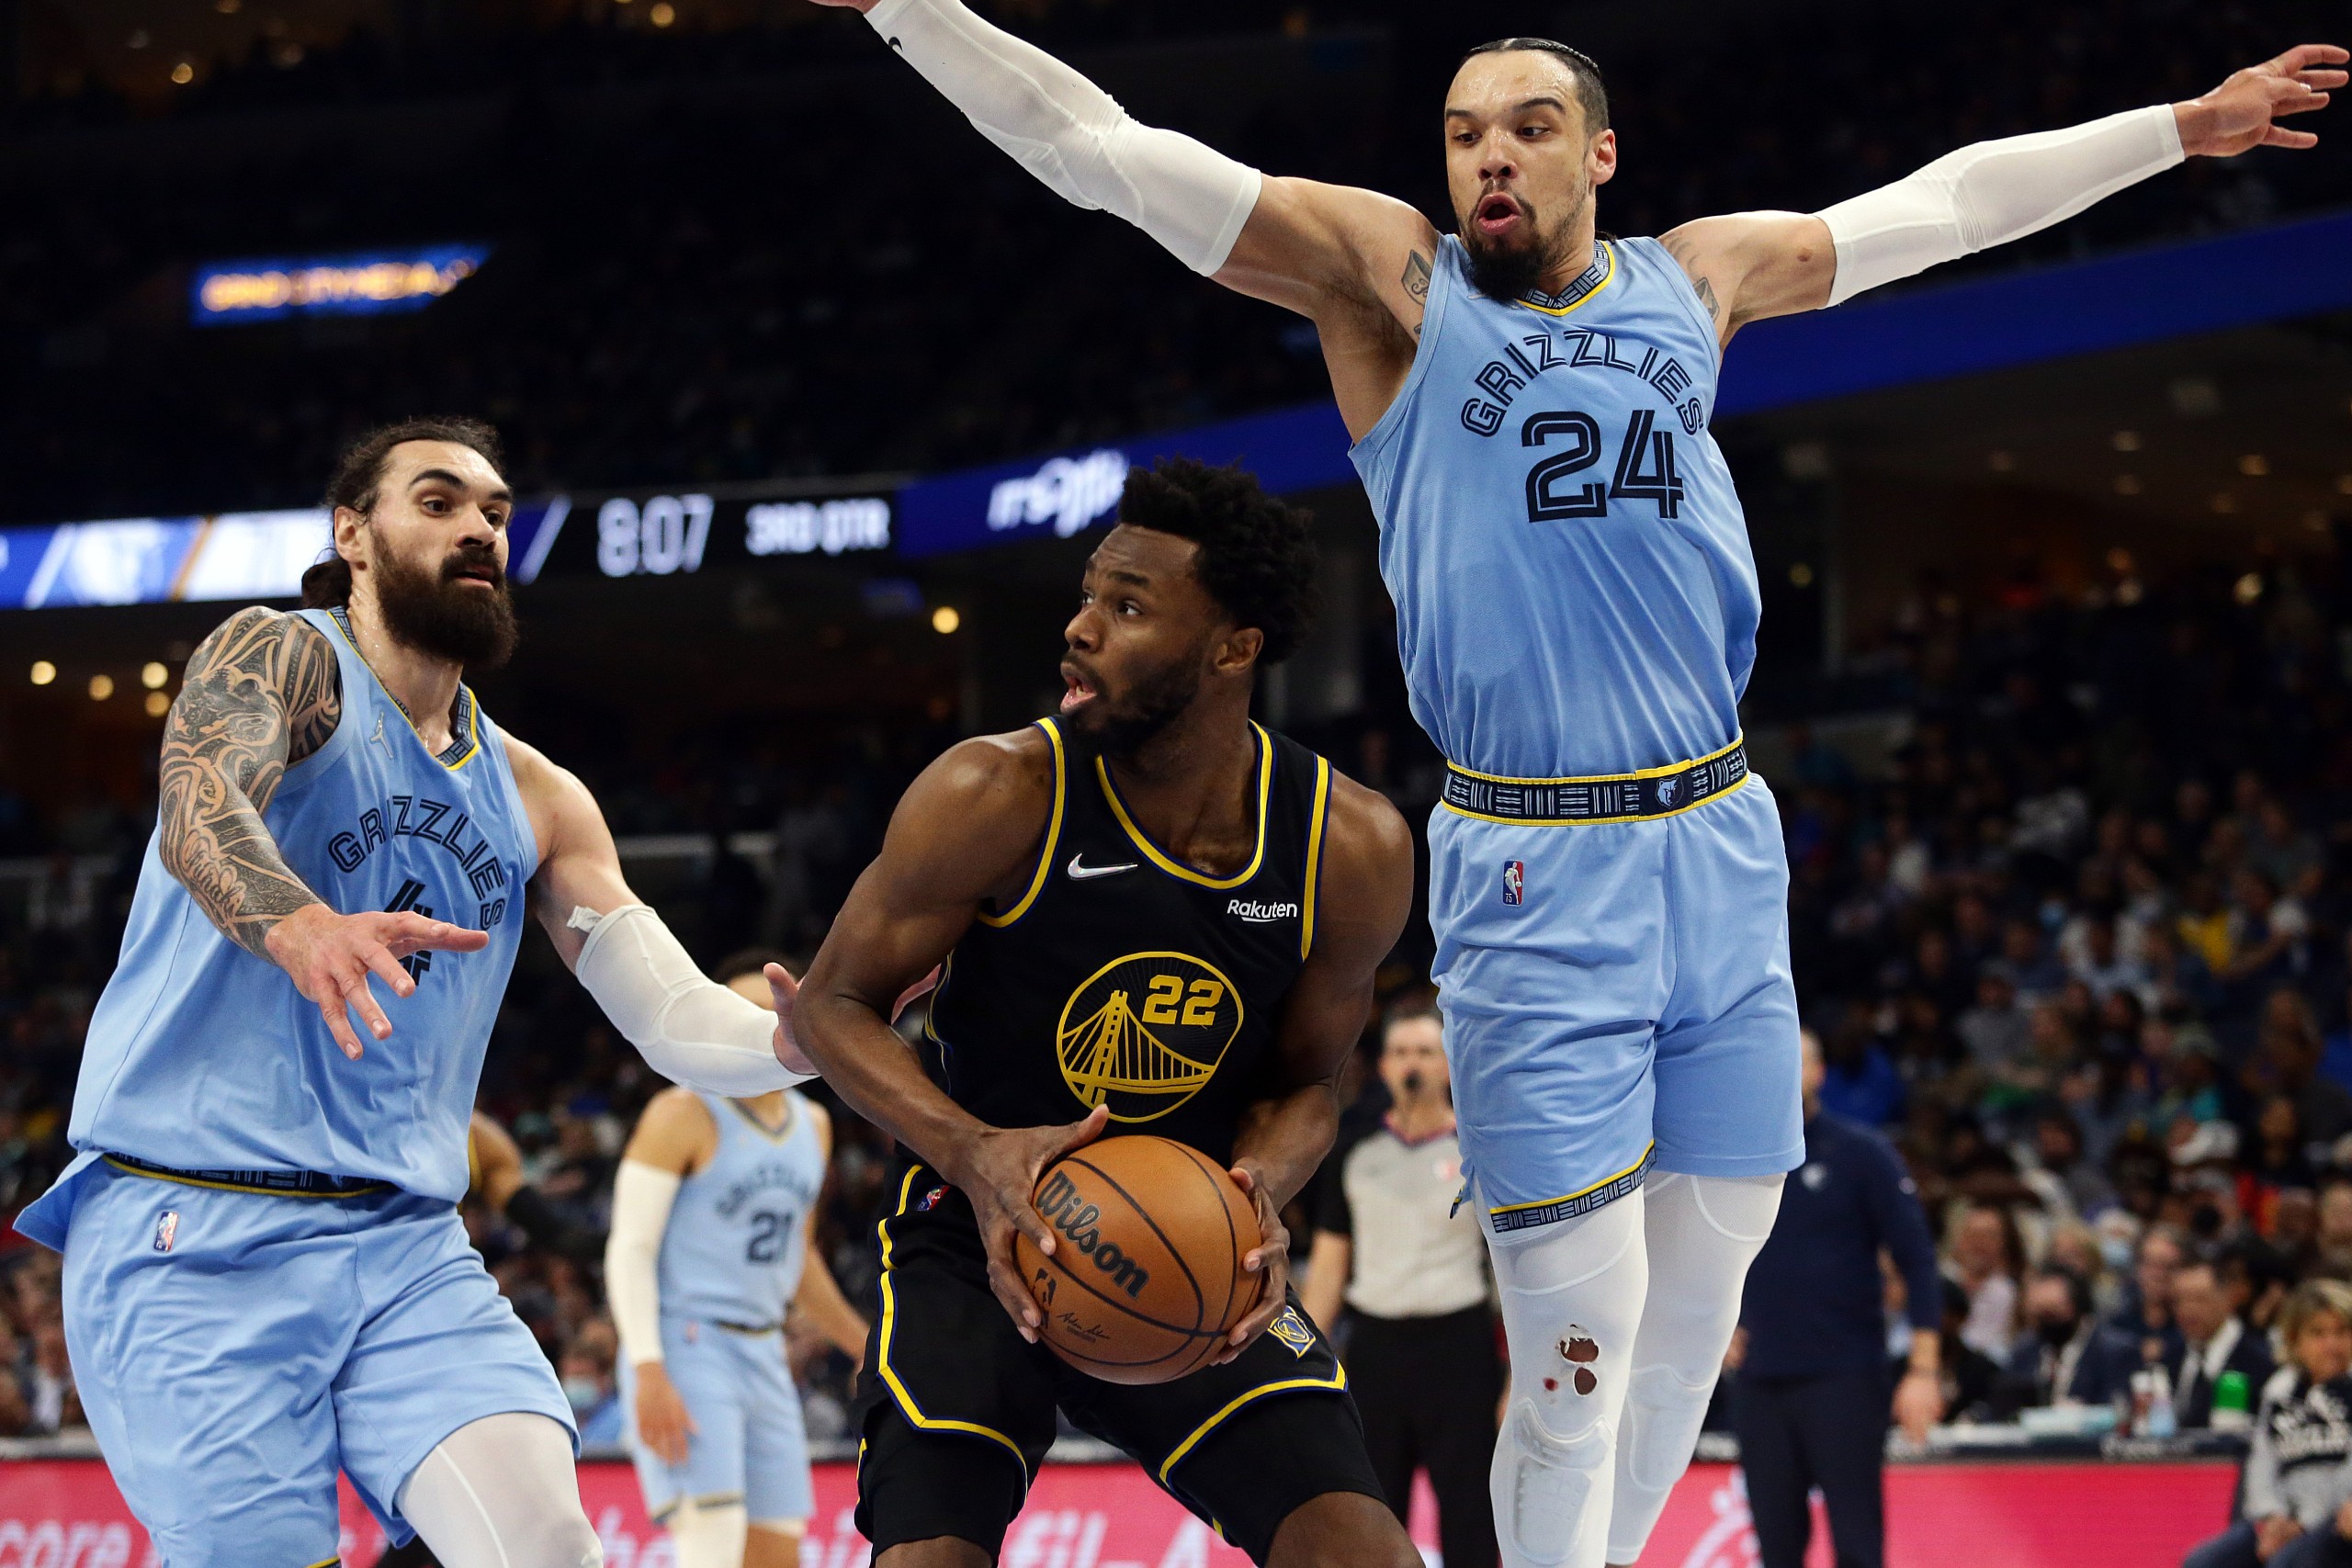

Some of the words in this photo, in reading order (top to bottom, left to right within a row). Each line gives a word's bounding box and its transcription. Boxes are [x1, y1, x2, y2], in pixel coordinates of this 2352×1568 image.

[1461, 330, 1704, 437] GRIZZLIES
[1521, 410, 1685, 523] 24
[328, 795, 505, 930] GRIZZLIES
[1227, 899, 1298, 921] Rakuten
[1142, 975, 1224, 1035] 22
[746, 1210, 794, 1264] 21
[1035, 1169, 1149, 1300] Wilson
